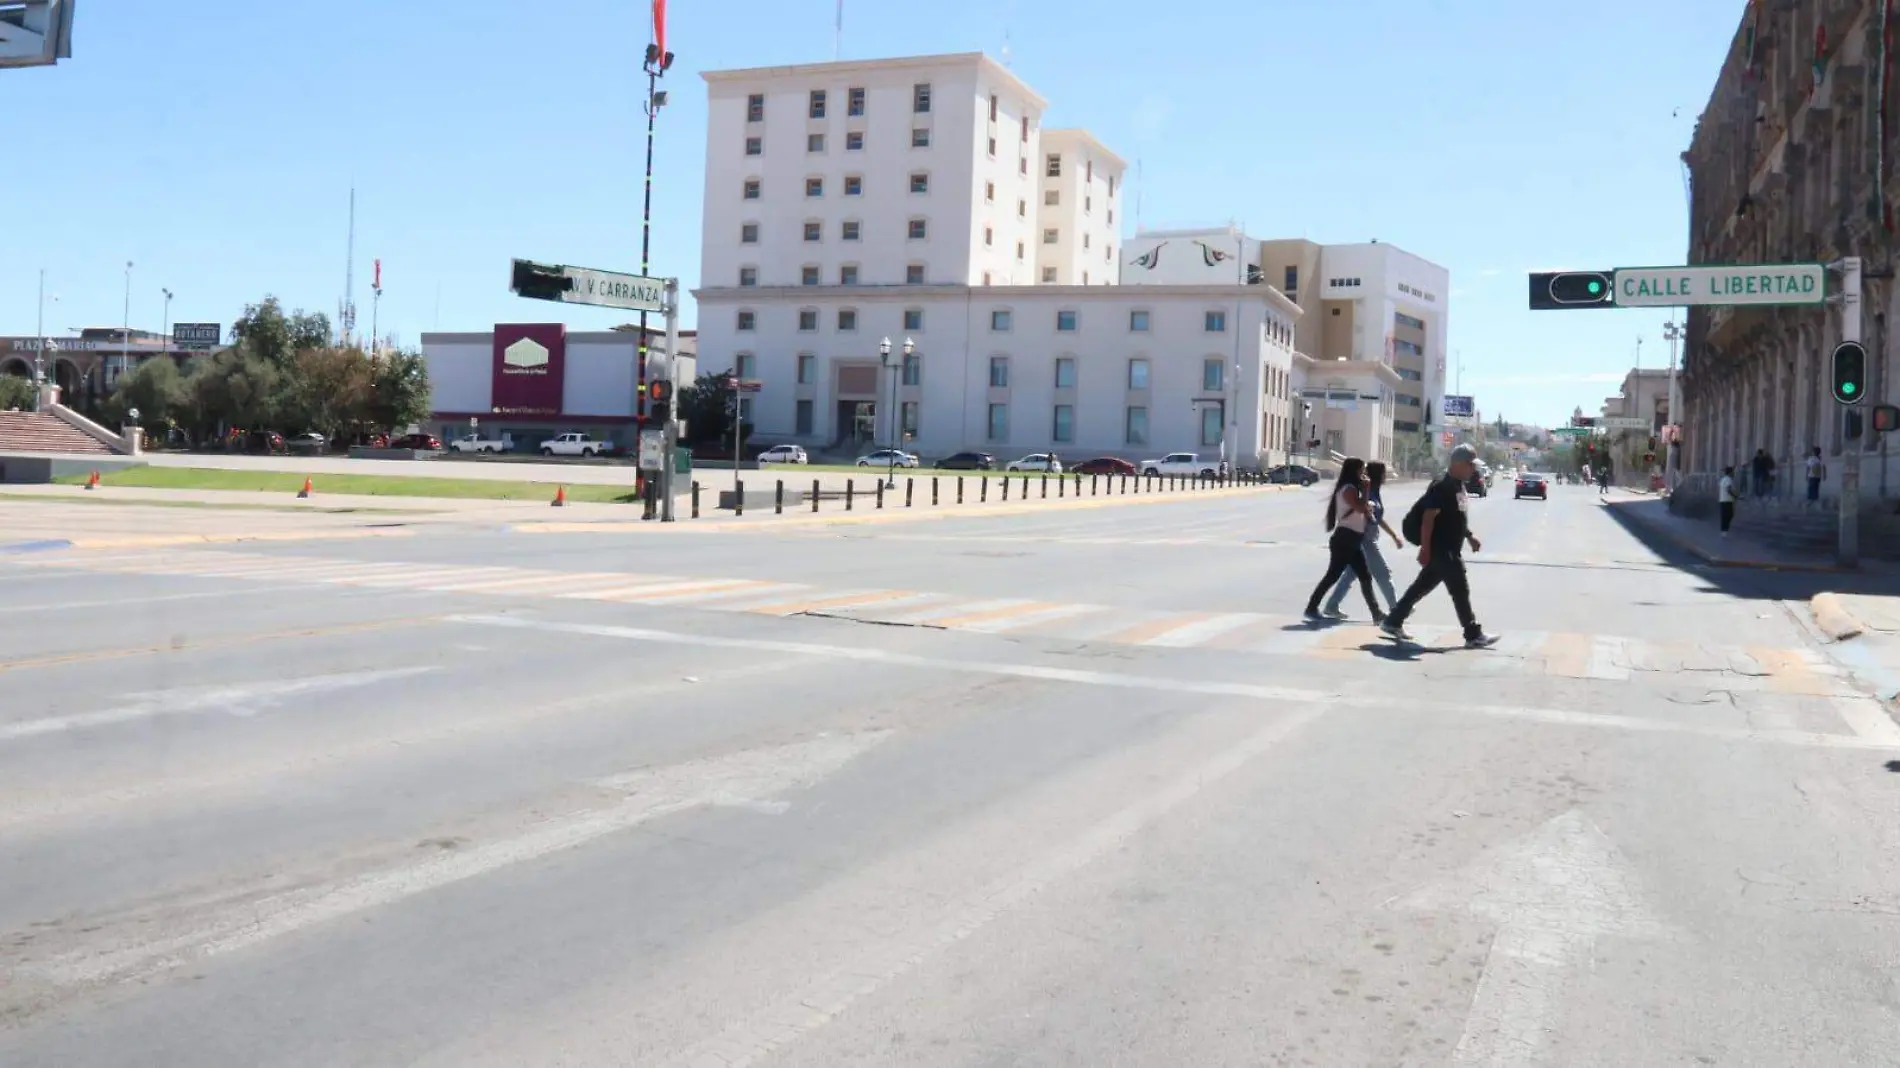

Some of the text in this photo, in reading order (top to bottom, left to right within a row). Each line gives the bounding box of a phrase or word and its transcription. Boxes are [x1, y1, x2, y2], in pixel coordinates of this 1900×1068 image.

[600, 280, 659, 301] CARRANZA
[1623, 274, 1815, 297] CALLE LIBERTAD
